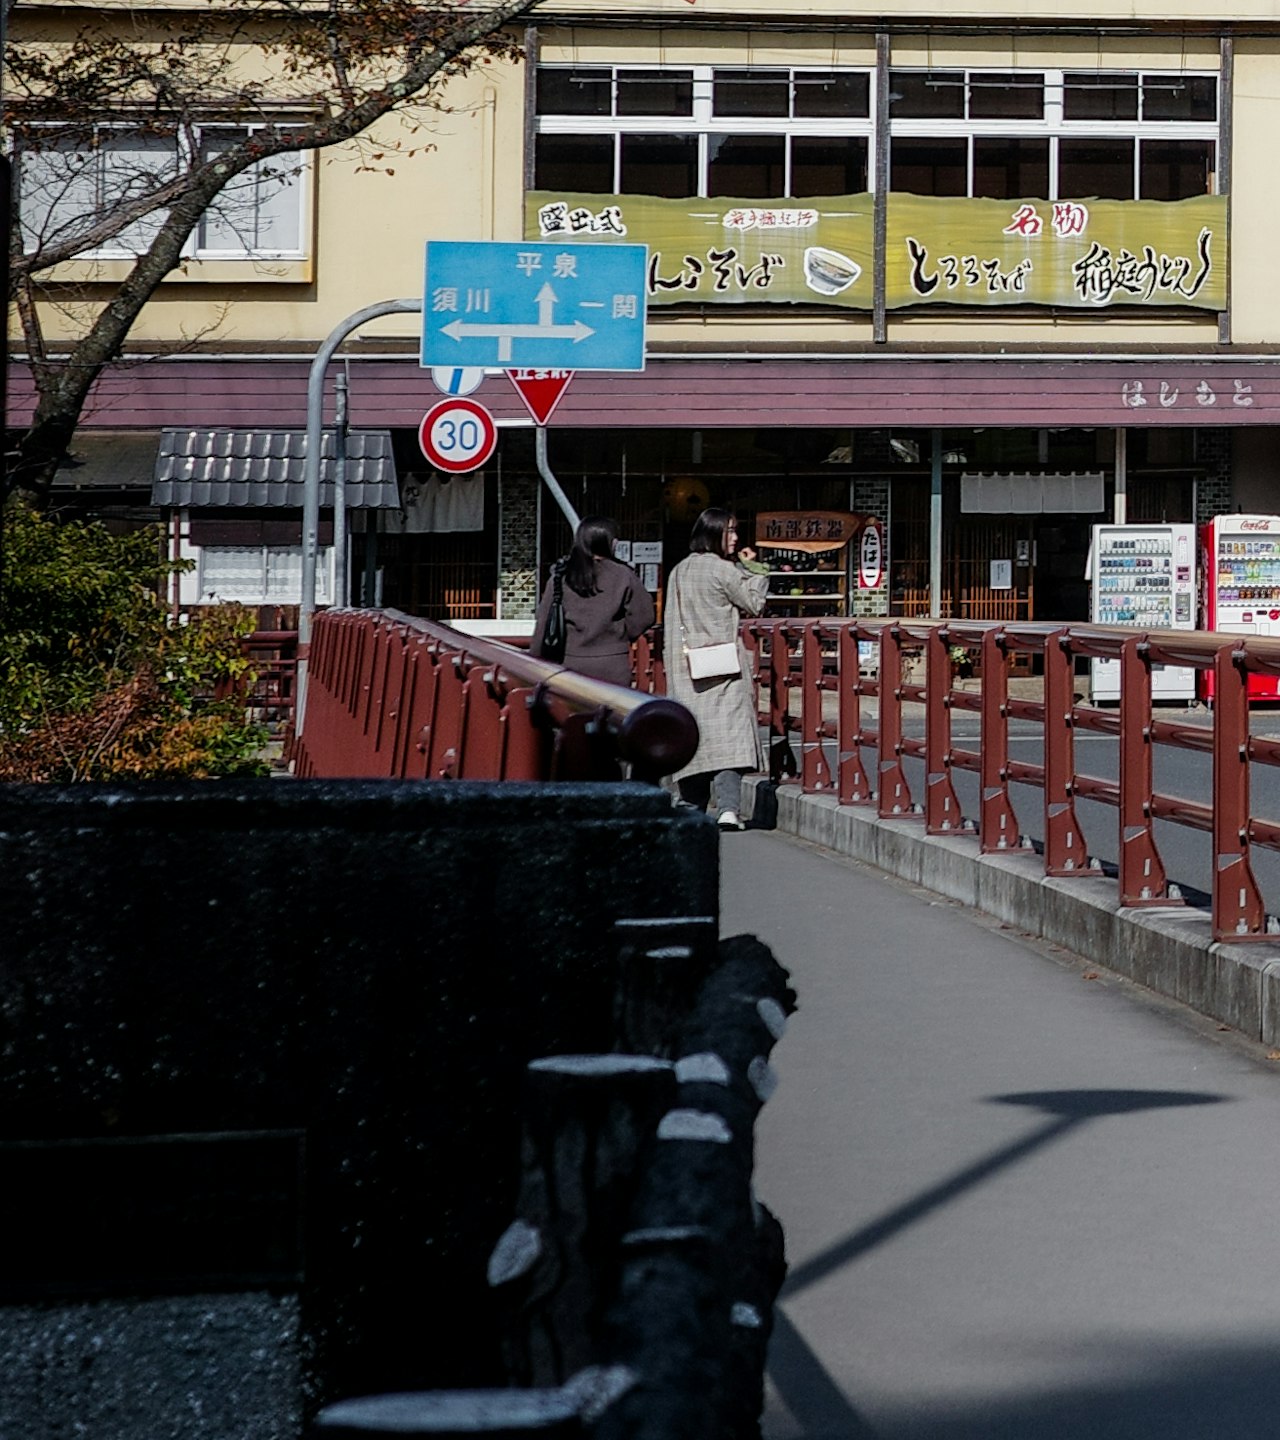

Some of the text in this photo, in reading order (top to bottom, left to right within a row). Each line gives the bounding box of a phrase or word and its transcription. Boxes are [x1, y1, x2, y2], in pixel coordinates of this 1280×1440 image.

[1003, 204, 1086, 235] 名物
[516, 252, 578, 279] 平泉
[432, 287, 638, 319] 須川 一関
[1122, 379, 1254, 408] はしもと
[437, 419, 479, 451] 30
[1240, 520, 1271, 531] Coca-Cola
[863, 532, 878, 578] たばこ
